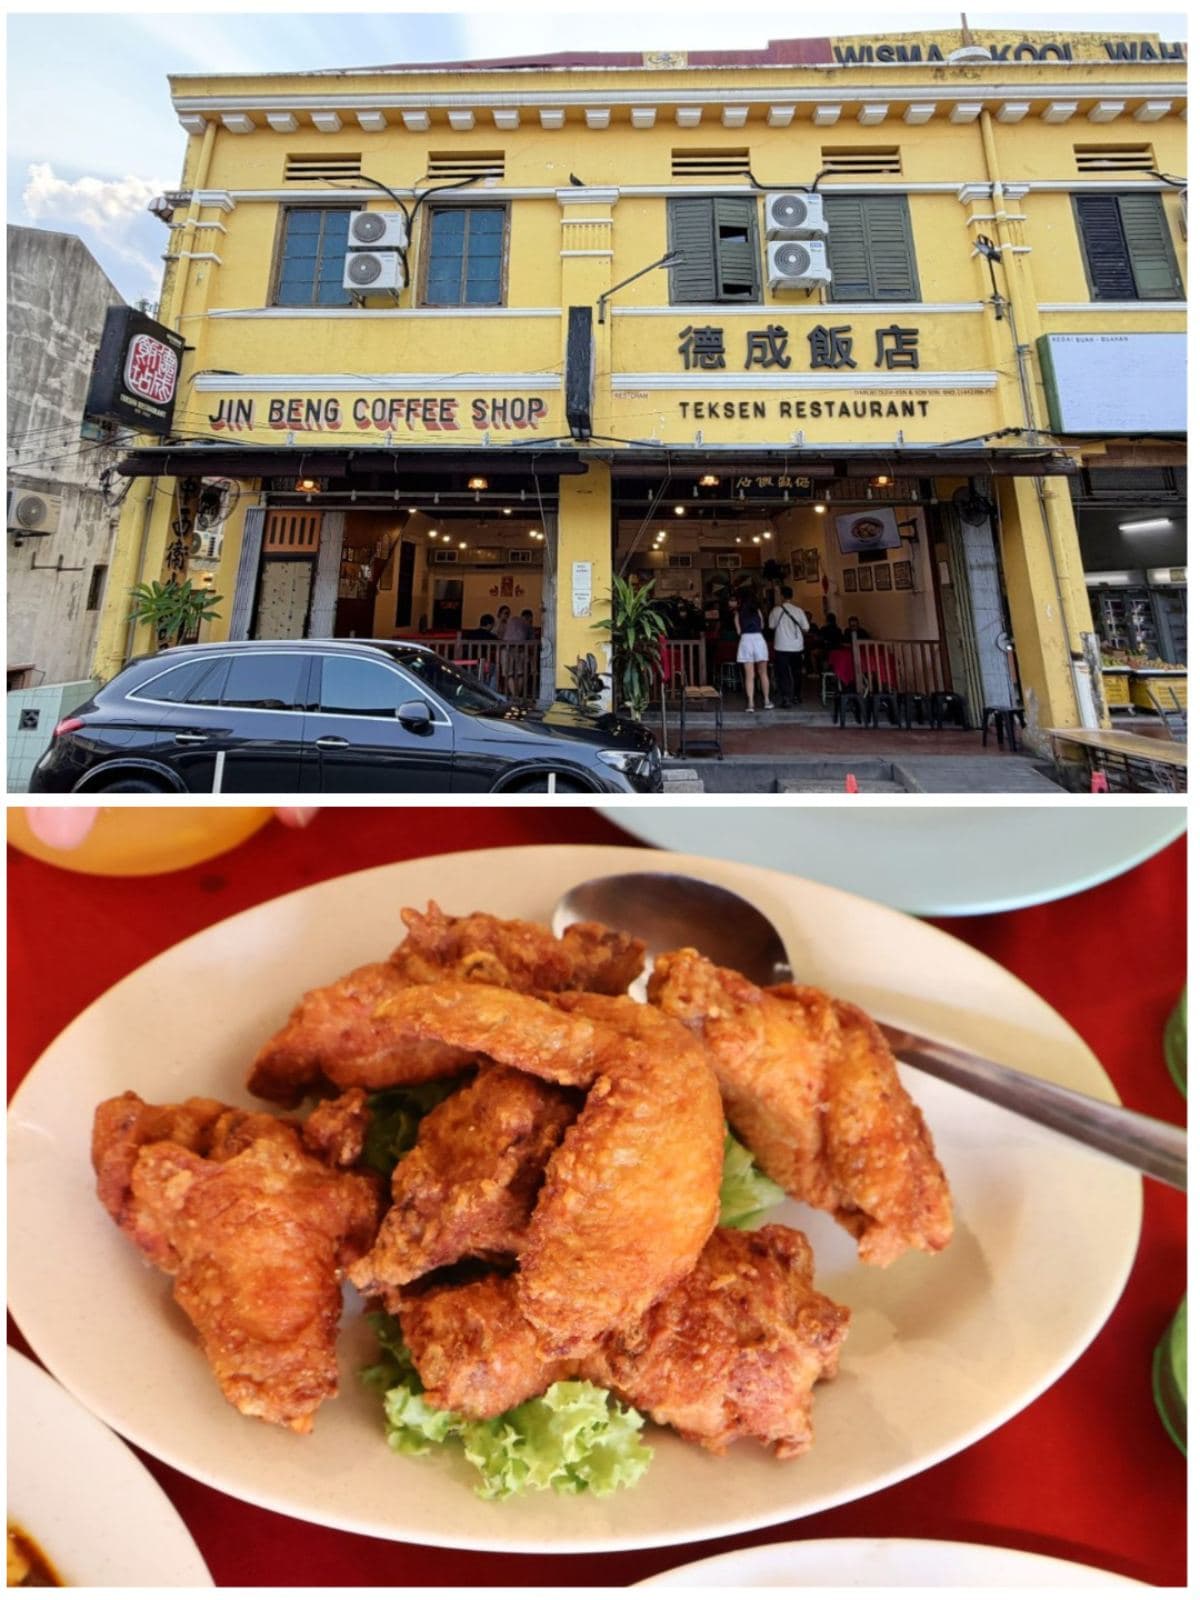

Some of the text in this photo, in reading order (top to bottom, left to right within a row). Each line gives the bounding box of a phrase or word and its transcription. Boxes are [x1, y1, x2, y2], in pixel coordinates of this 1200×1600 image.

[677, 324, 920, 370] 德成飯店
[208, 398, 548, 430] JIN BENG COFFEE SHOP
[678, 400, 930, 419] TEKSEN RESTAURANT
